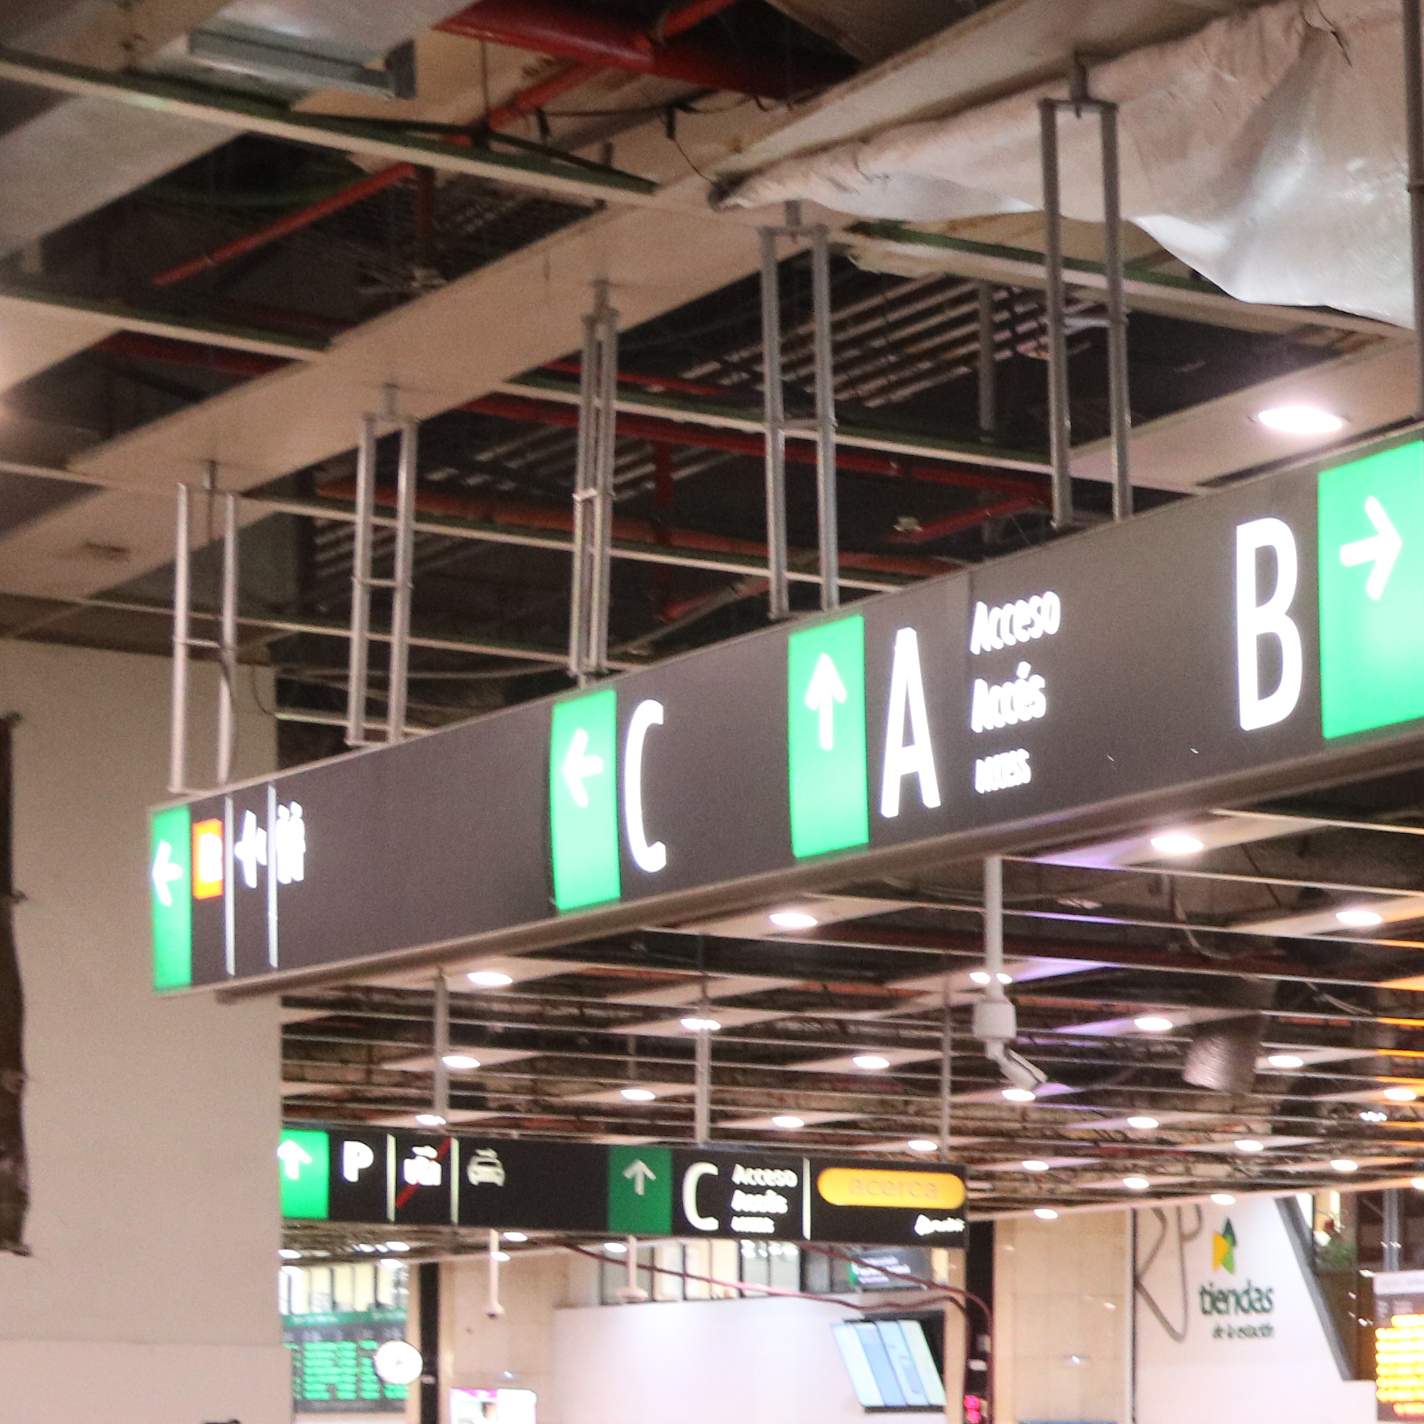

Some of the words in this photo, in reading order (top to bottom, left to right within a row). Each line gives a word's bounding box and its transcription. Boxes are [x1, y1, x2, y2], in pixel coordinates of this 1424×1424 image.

[970, 591, 1061, 655] Acceso
[1233, 514, 1304, 731] B
[880, 627, 941, 818] A
[624, 699, 667, 873] C
[342, 1140, 374, 1182] P
[731, 1163, 798, 1187] Acceso
[682, 1162, 719, 1231] C
[1200, 1279, 1274, 1315] tiendas
